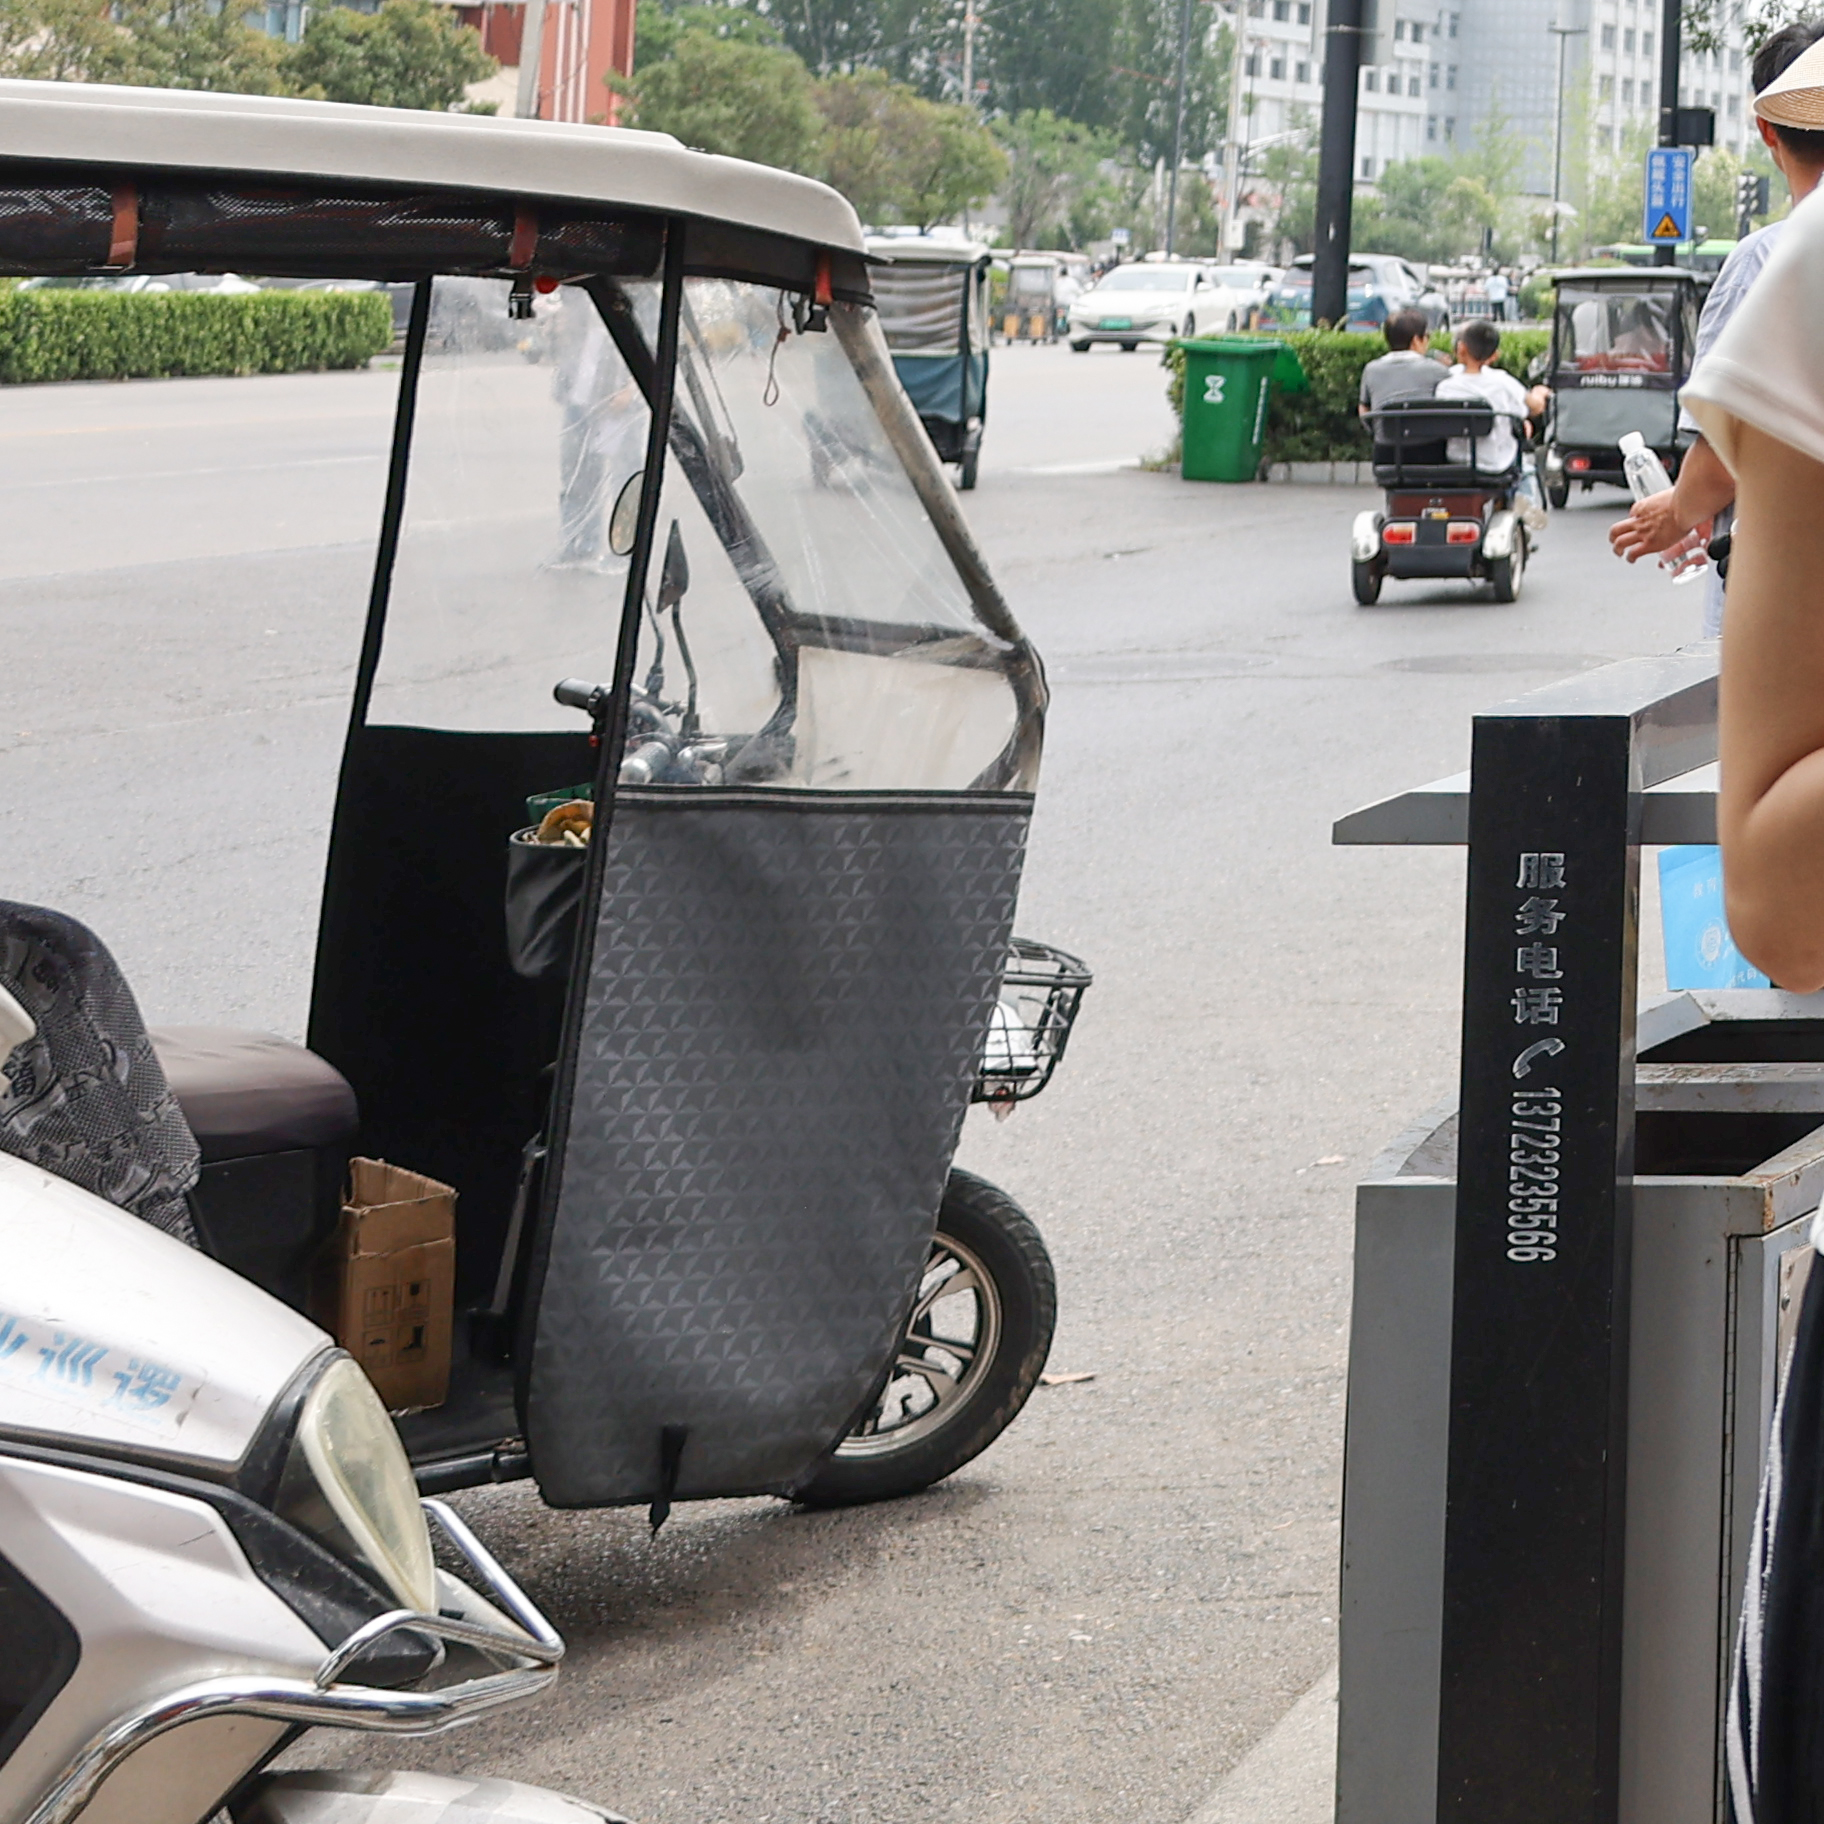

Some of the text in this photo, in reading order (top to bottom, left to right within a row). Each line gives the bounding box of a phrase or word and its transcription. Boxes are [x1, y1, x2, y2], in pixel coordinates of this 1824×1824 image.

[1506, 852, 1566, 1263] 服务电话 13723235566
